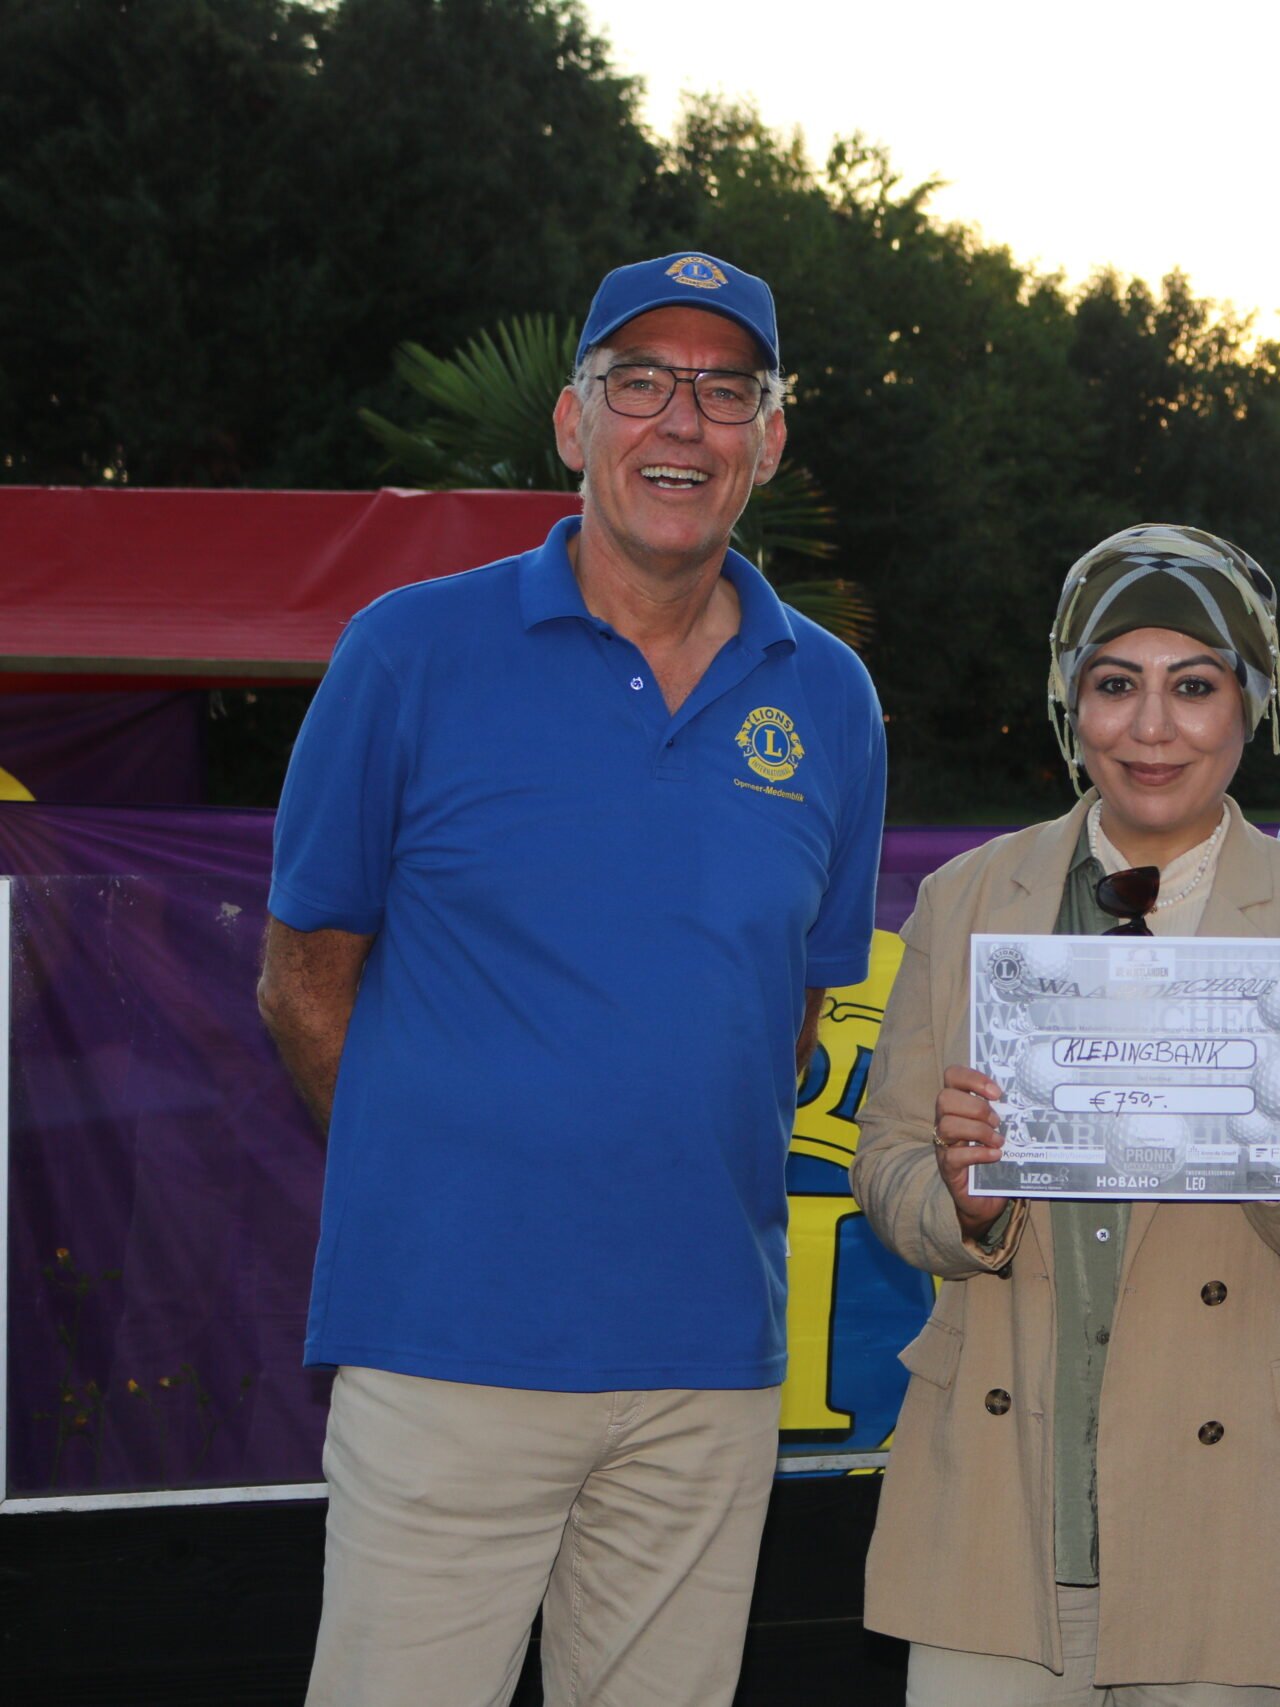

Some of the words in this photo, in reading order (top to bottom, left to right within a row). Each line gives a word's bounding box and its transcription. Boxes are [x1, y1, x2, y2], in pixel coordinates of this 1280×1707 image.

[753, 709, 791, 729] LIONS
[764, 729, 783, 757] L
[1000, 961, 1015, 979] L
[1063, 1038, 1229, 1069] KLEDINGBANK
[1125, 1148, 1174, 1163] PRONK
[1020, 1173, 1052, 1185] LIZO
[1185, 1177, 1206, 1192] LEO
